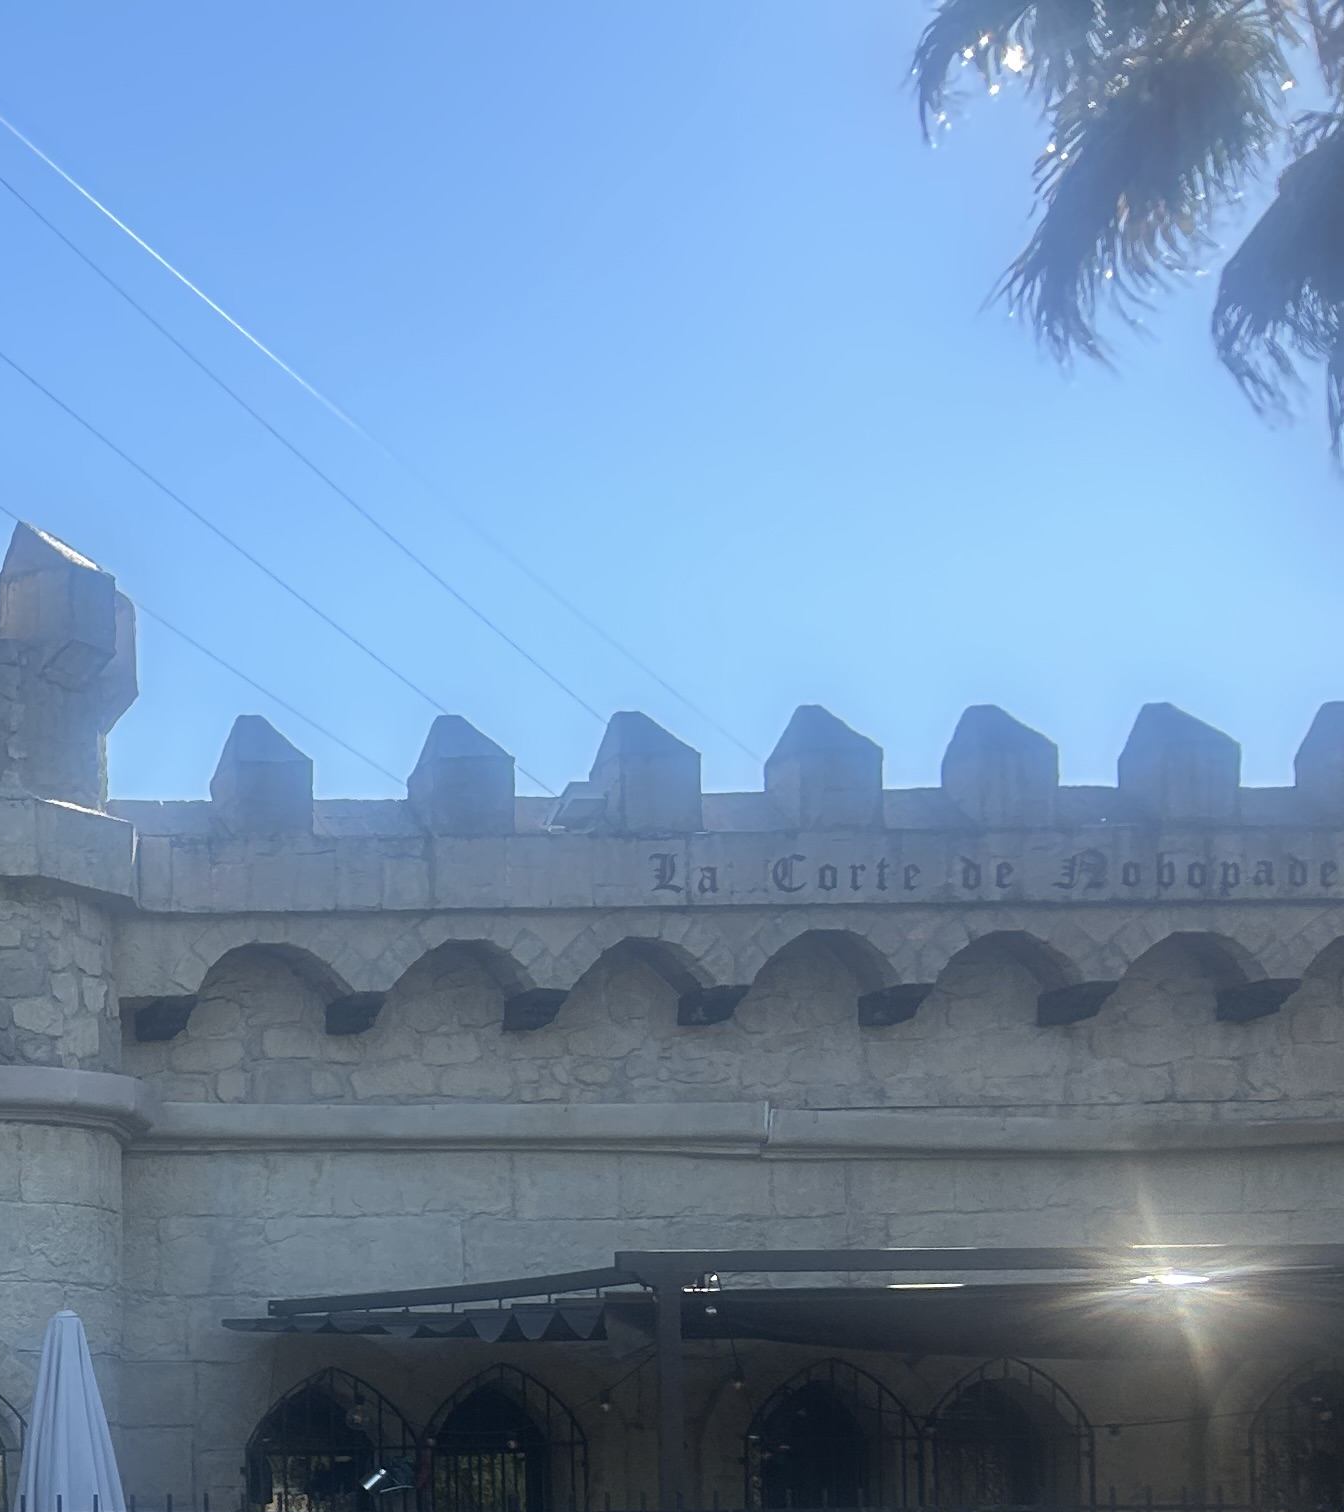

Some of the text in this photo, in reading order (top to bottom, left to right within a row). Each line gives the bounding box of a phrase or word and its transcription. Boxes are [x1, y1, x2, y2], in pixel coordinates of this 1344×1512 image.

[647, 851, 720, 893] La
[771, 852, 923, 893] Corte
[959, 854, 1015, 892] de
